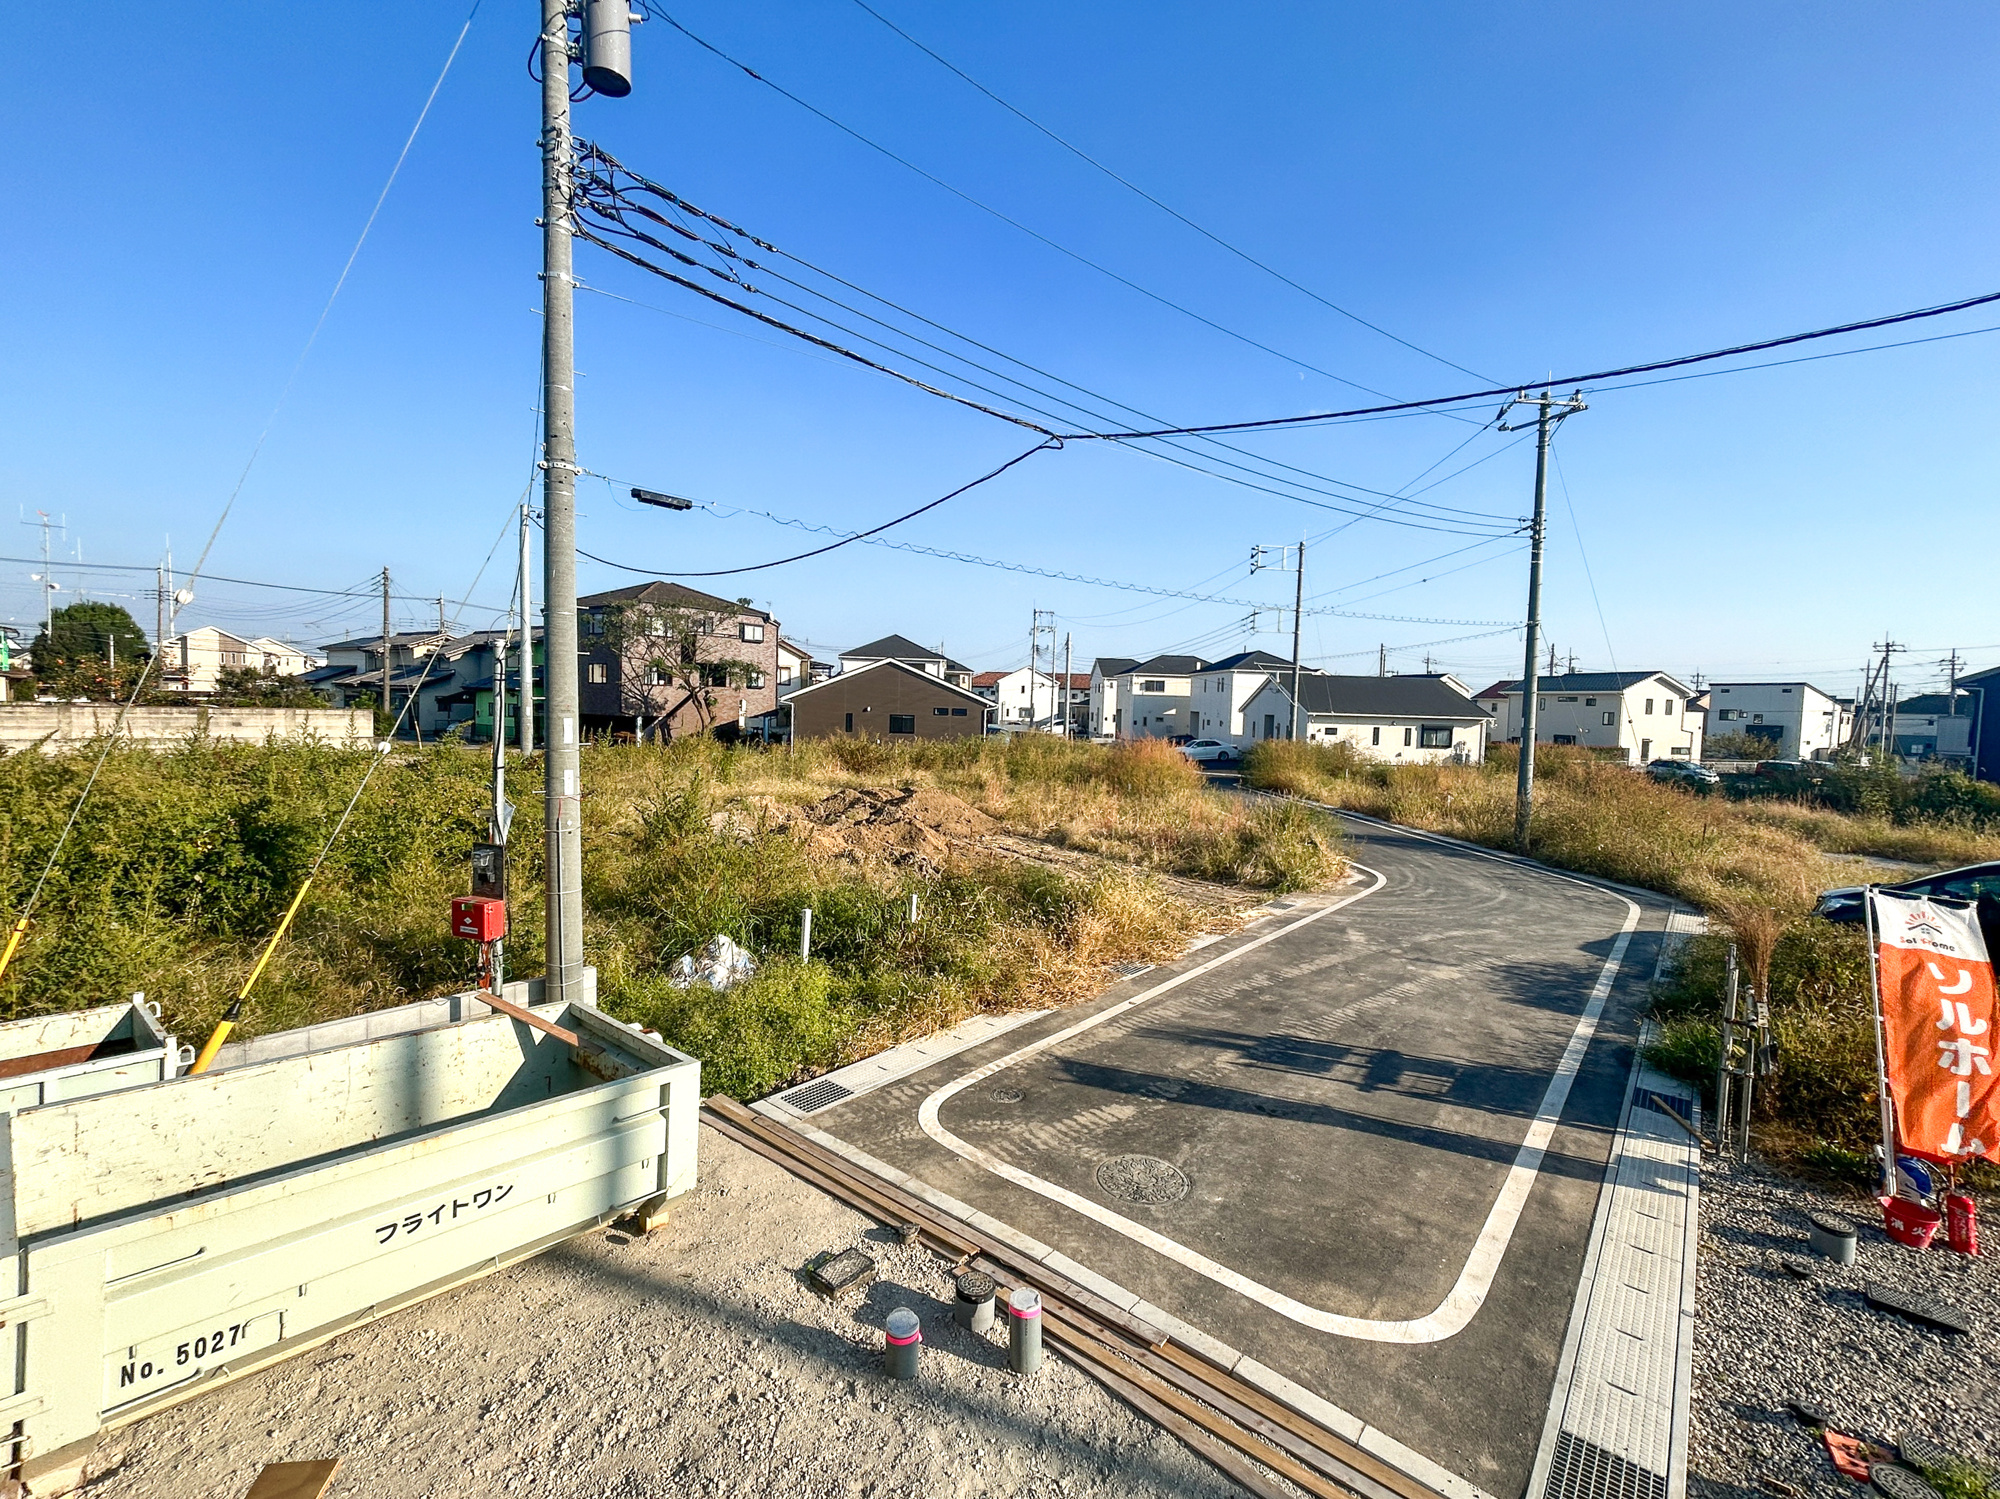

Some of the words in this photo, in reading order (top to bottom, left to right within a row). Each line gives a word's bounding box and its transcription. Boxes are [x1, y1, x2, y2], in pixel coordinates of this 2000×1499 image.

[1928, 962, 1992, 1155] ソルホーム
[375, 1184, 514, 1245] フライトワン
[120, 1359, 164, 1388] No.
[177, 1323, 241, 1365] 5027
